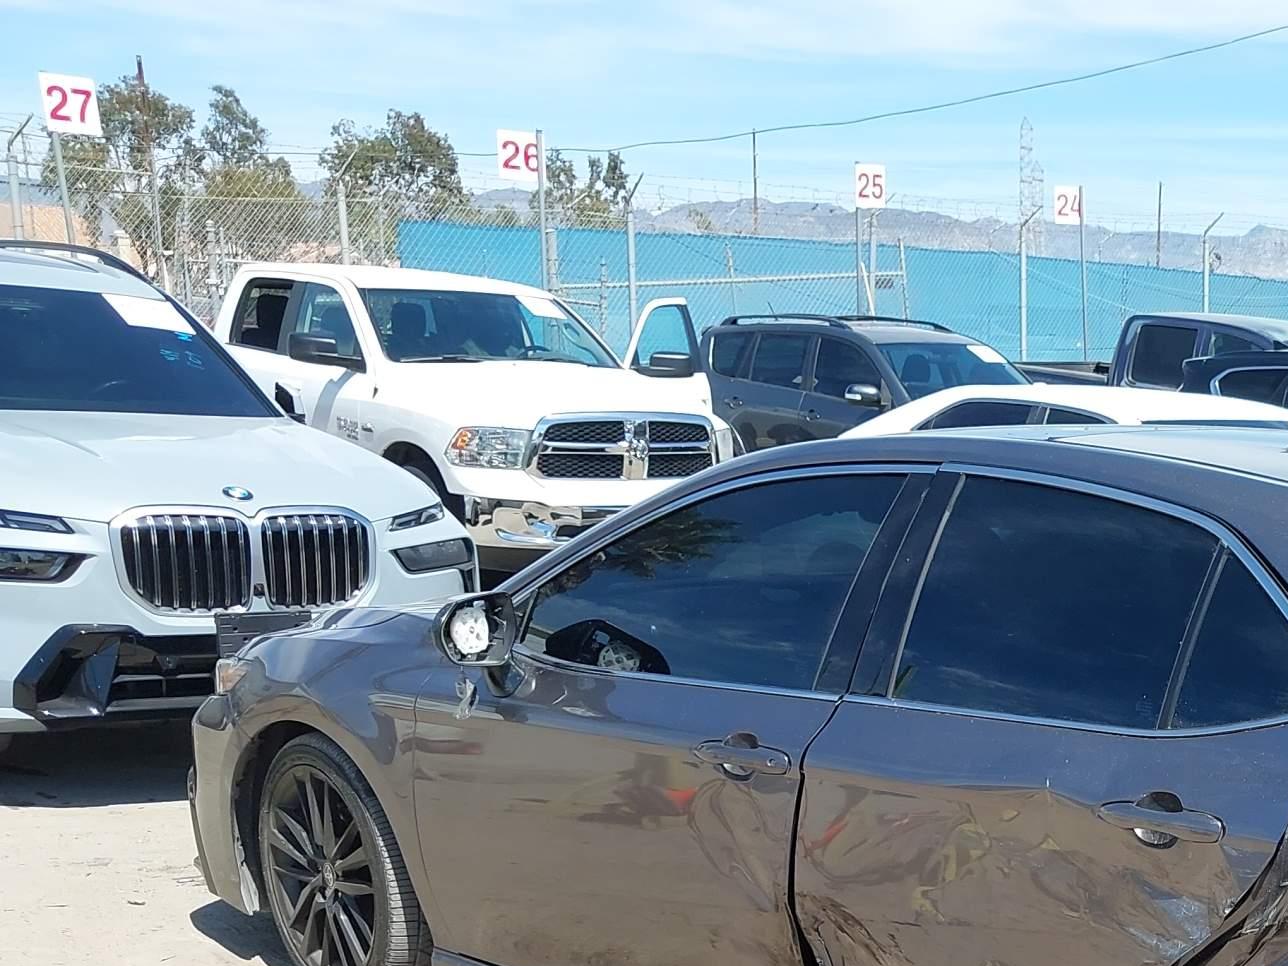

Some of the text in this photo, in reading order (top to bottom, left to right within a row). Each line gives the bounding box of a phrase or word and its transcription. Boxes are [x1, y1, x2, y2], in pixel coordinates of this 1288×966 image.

[46, 85, 92, 123] 27
[502, 140, 538, 172] 26
[858, 172, 883, 199] 25
[1057, 193, 1081, 217] 24
